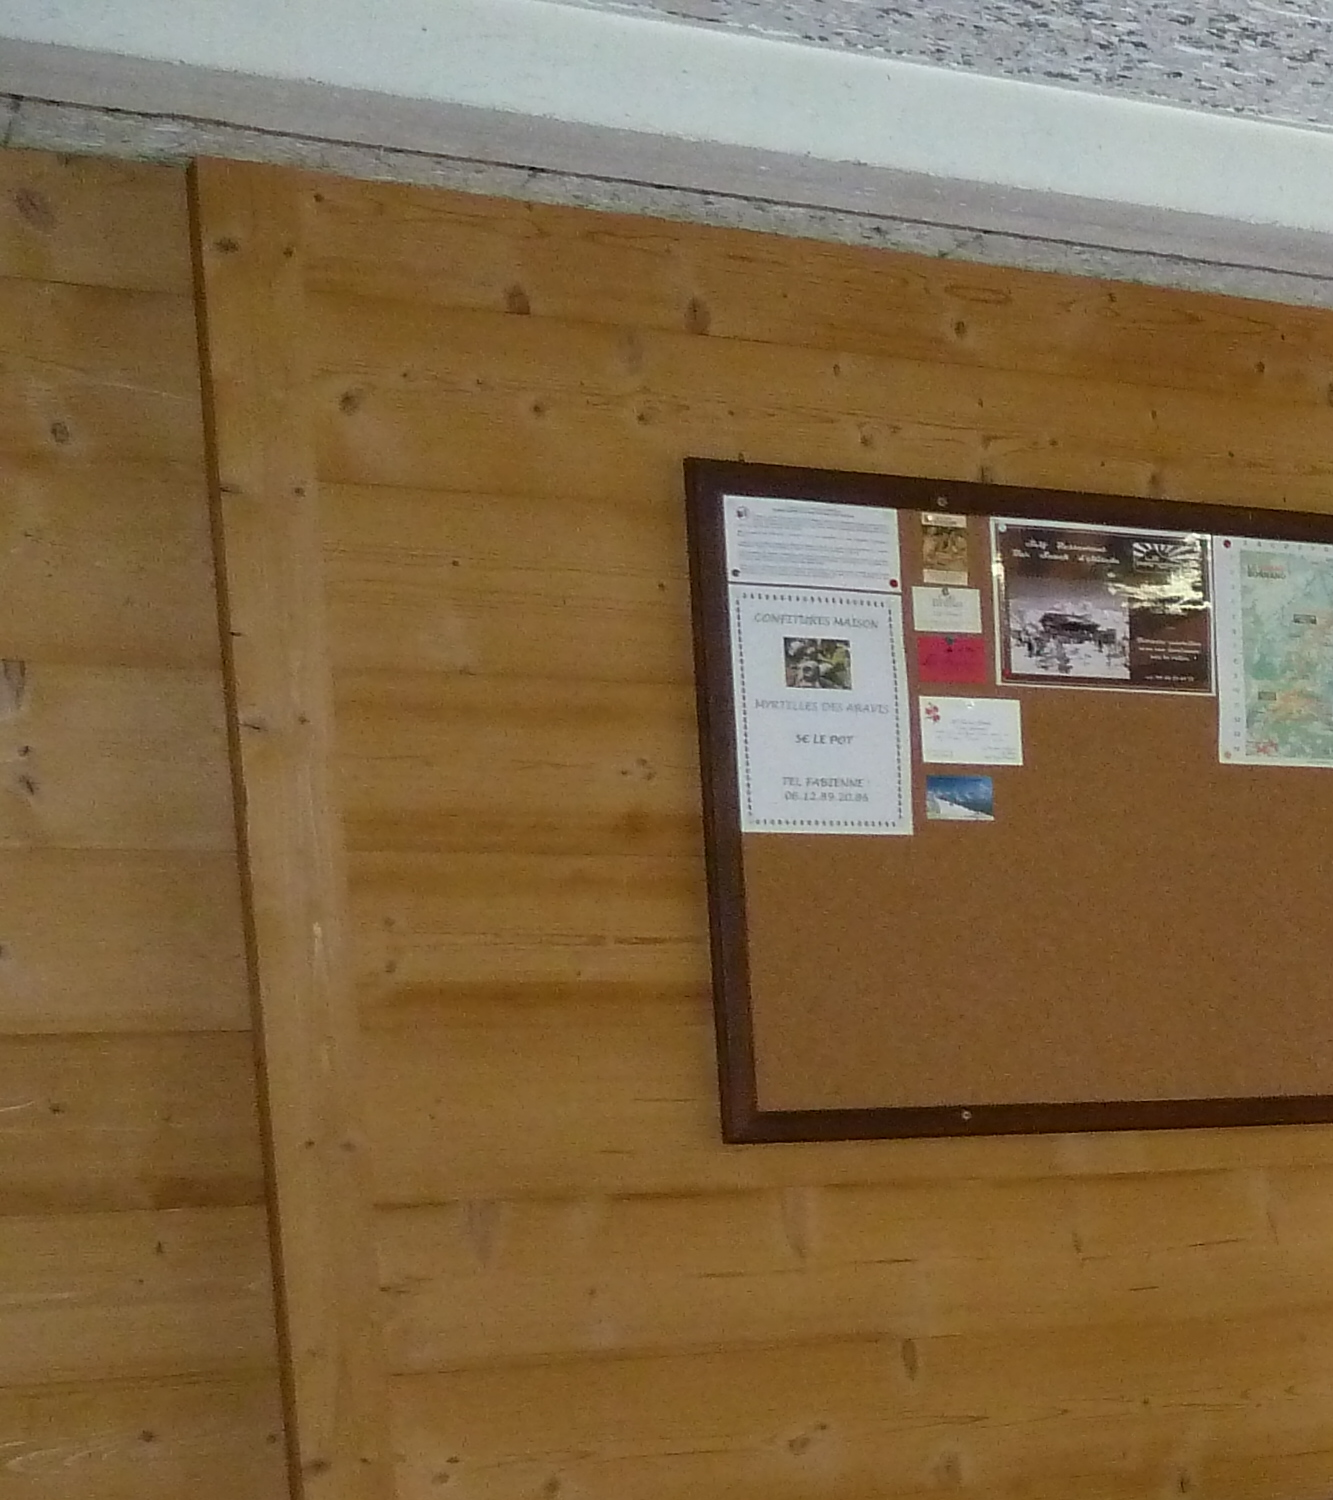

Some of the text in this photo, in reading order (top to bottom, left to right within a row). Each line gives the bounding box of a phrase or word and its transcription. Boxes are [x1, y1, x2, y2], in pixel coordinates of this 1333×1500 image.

[754, 613, 879, 629] CONFITURES MAISON
[755, 699, 890, 715] MYRTILLES DES ARAVIS
[813, 734, 826, 745] LE
[829, 735, 854, 745] POT
[782, 776, 864, 788] TEL FABIENNE
